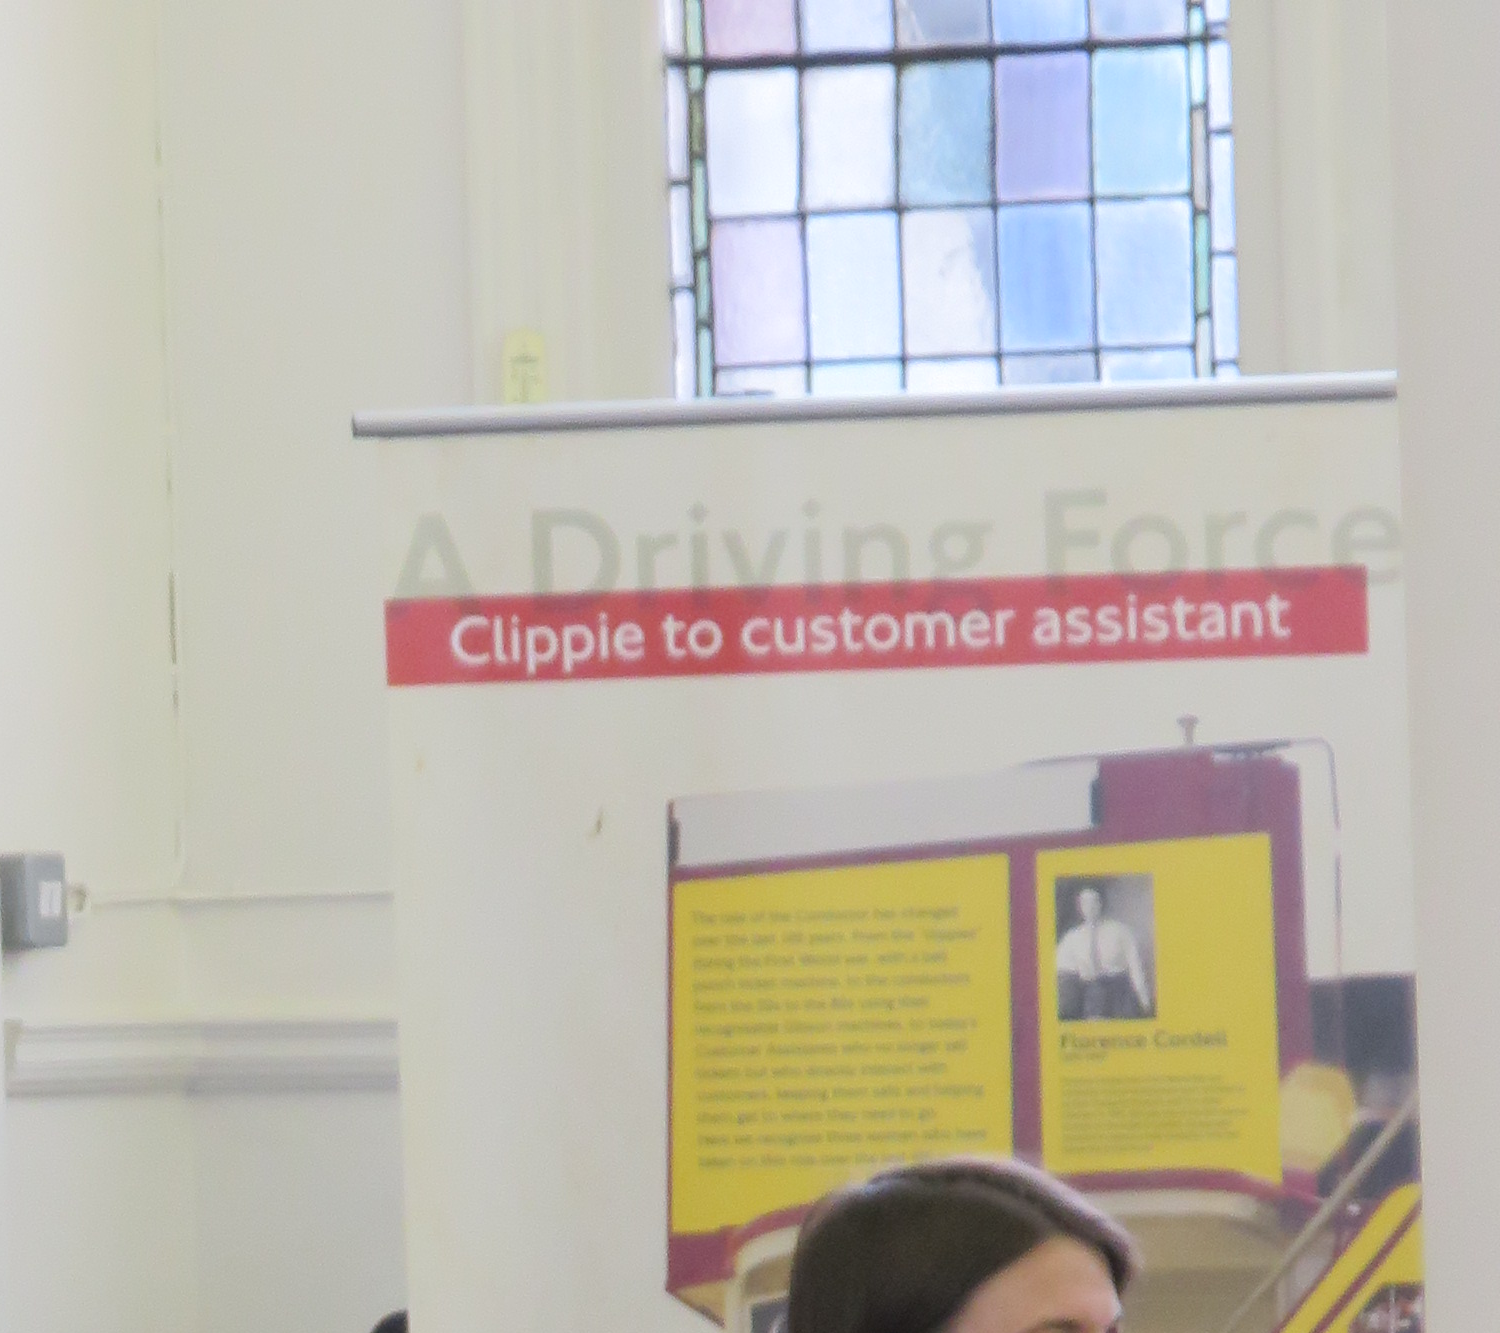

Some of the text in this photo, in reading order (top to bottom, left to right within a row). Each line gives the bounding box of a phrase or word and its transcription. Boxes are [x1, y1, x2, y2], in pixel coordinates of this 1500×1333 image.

[392, 489, 1400, 626] A Driving Force
[448, 592, 1292, 677] Clippie to customer assistant
[1060, 1031, 1148, 1051] Florence
